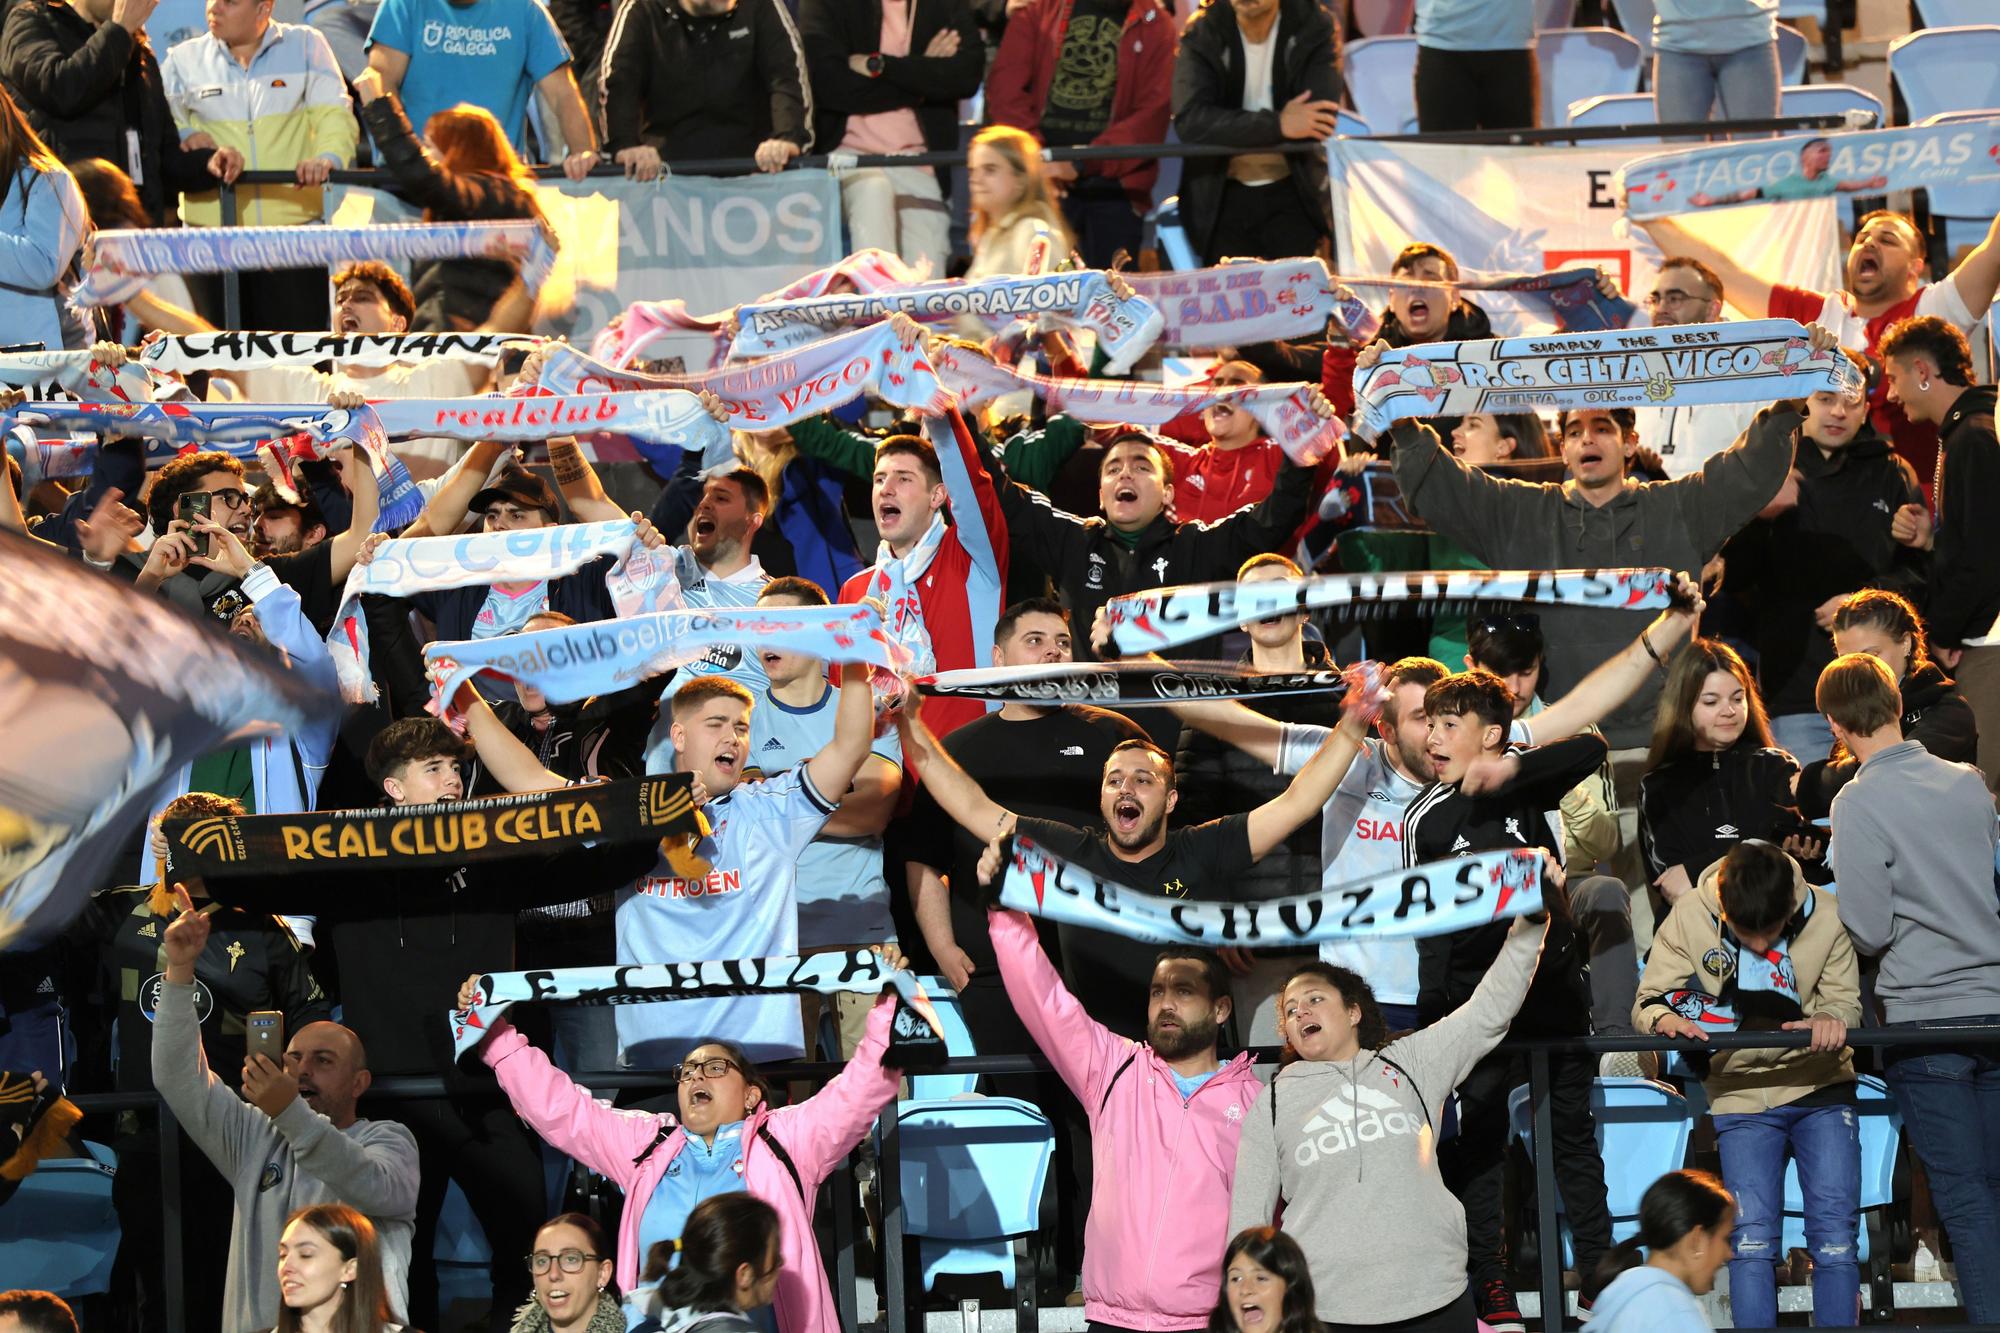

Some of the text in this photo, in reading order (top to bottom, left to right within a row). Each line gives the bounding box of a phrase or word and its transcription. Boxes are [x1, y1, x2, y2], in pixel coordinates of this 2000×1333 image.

[1692, 131, 1976, 191] IAGO ASPAS
[752, 299, 888, 335] AFOUTEZA
[1529, 330, 1721, 354] SIMPLY THE BEST
[1545, 354, 1652, 386] CELTA
[1663, 346, 1761, 380] VIGO
[777, 355, 872, 415] VIGO
[436, 396, 620, 428] realclub
[281, 801, 602, 861] REAL CLUB CELTA
[1294, 1109, 1422, 1167] adidas
